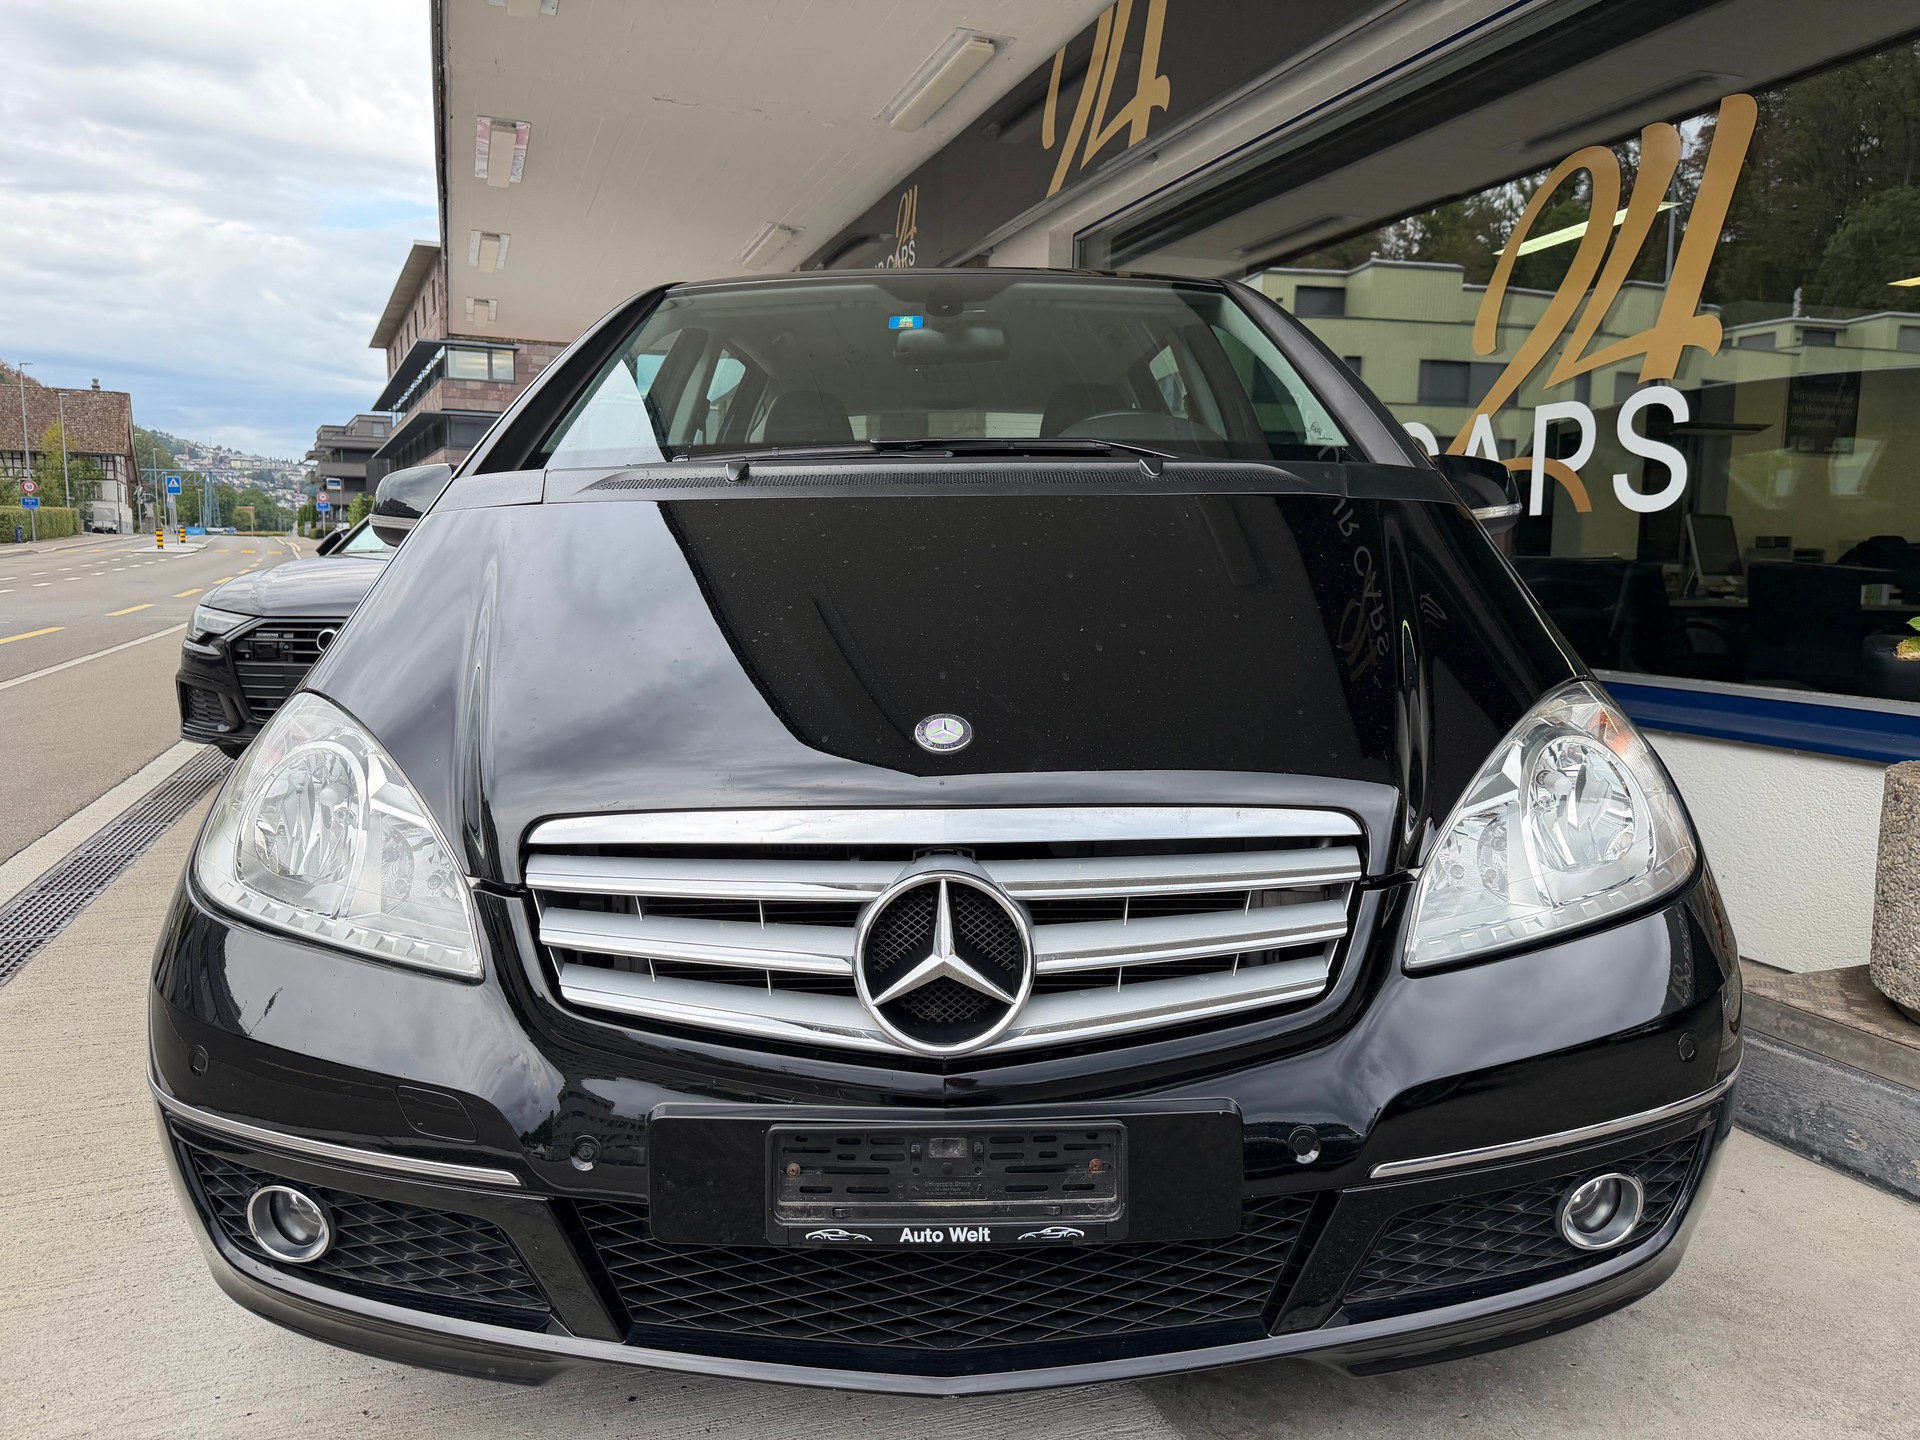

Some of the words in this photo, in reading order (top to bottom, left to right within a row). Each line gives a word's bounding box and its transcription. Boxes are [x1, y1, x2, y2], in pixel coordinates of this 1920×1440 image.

[886, 239, 917, 269] CARS
[1446, 93, 1758, 456] 24
[1401, 385, 1691, 516] RS
[899, 1227, 944, 1243] Auto
[948, 1227, 991, 1242] Welt
